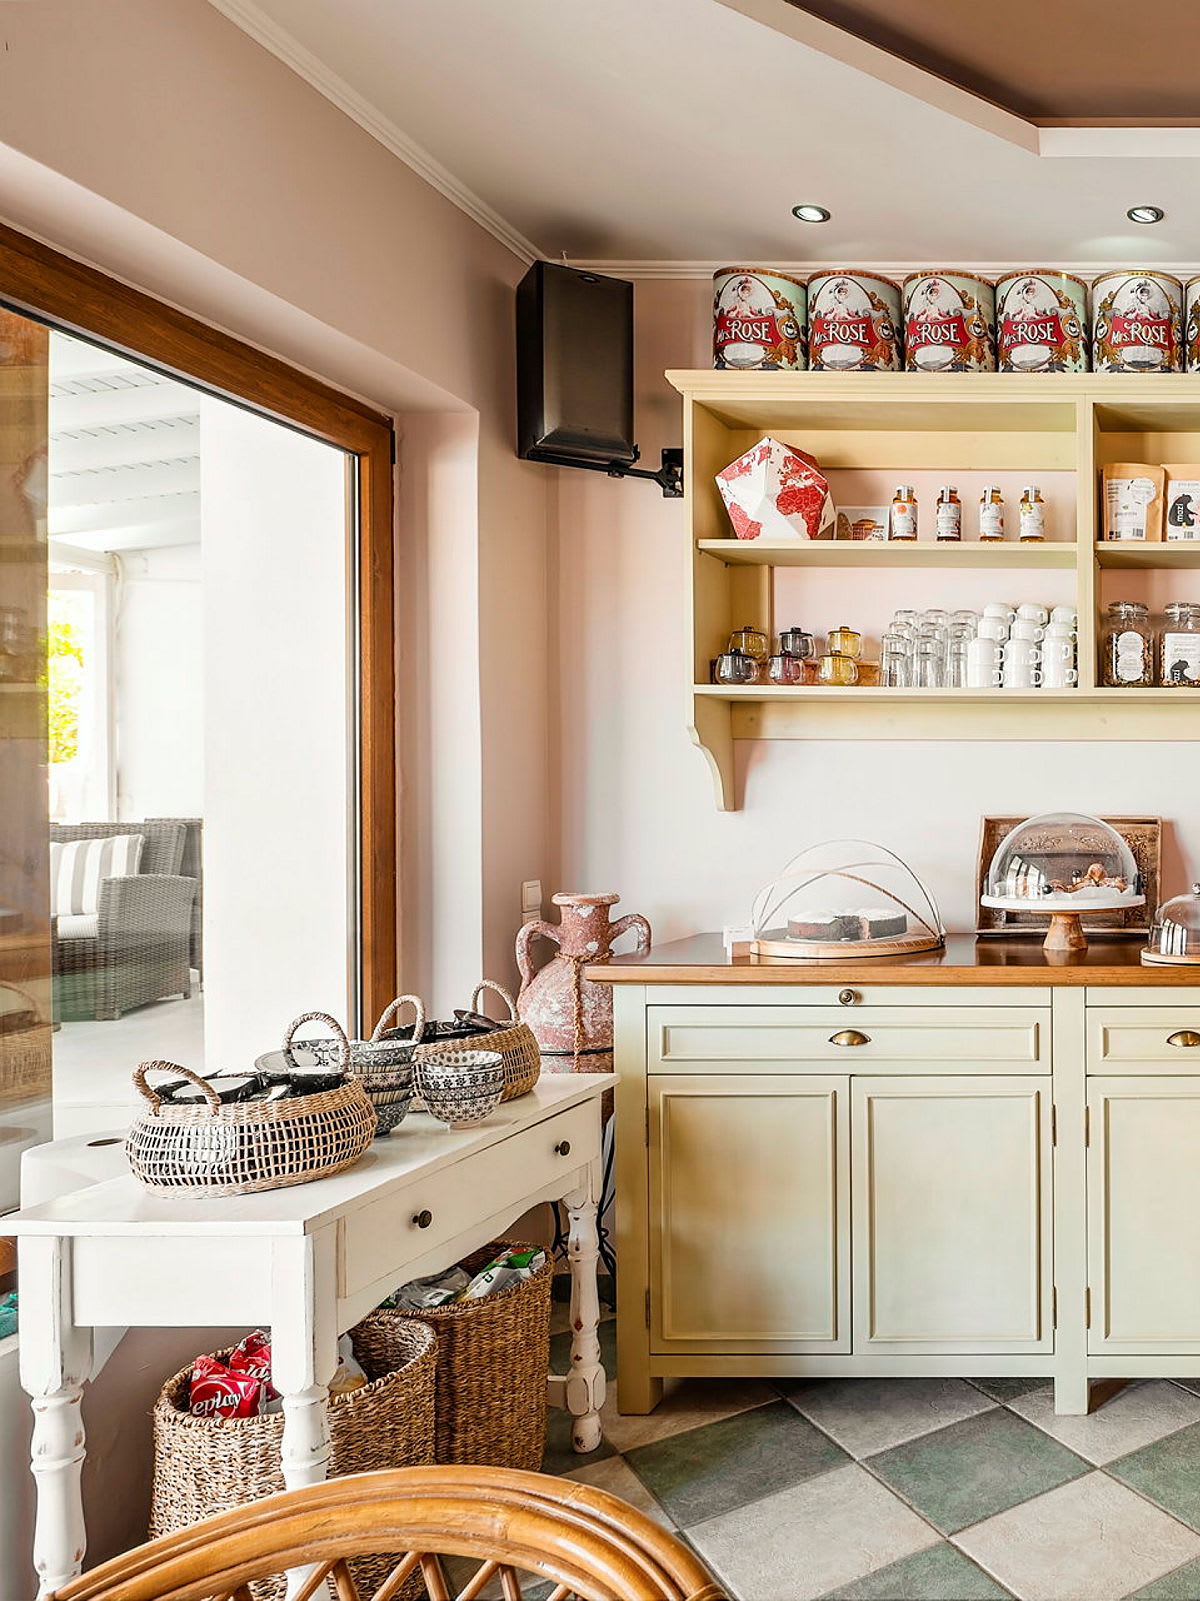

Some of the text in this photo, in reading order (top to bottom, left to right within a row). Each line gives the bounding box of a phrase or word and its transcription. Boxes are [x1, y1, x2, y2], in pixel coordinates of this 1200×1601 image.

[726, 320, 772, 342] ROSE
[824, 322, 869, 344] ROSE
[916, 323, 961, 344] ROSE
[1013, 322, 1057, 344] ROSE
[1124, 322, 1168, 346] ROSE
